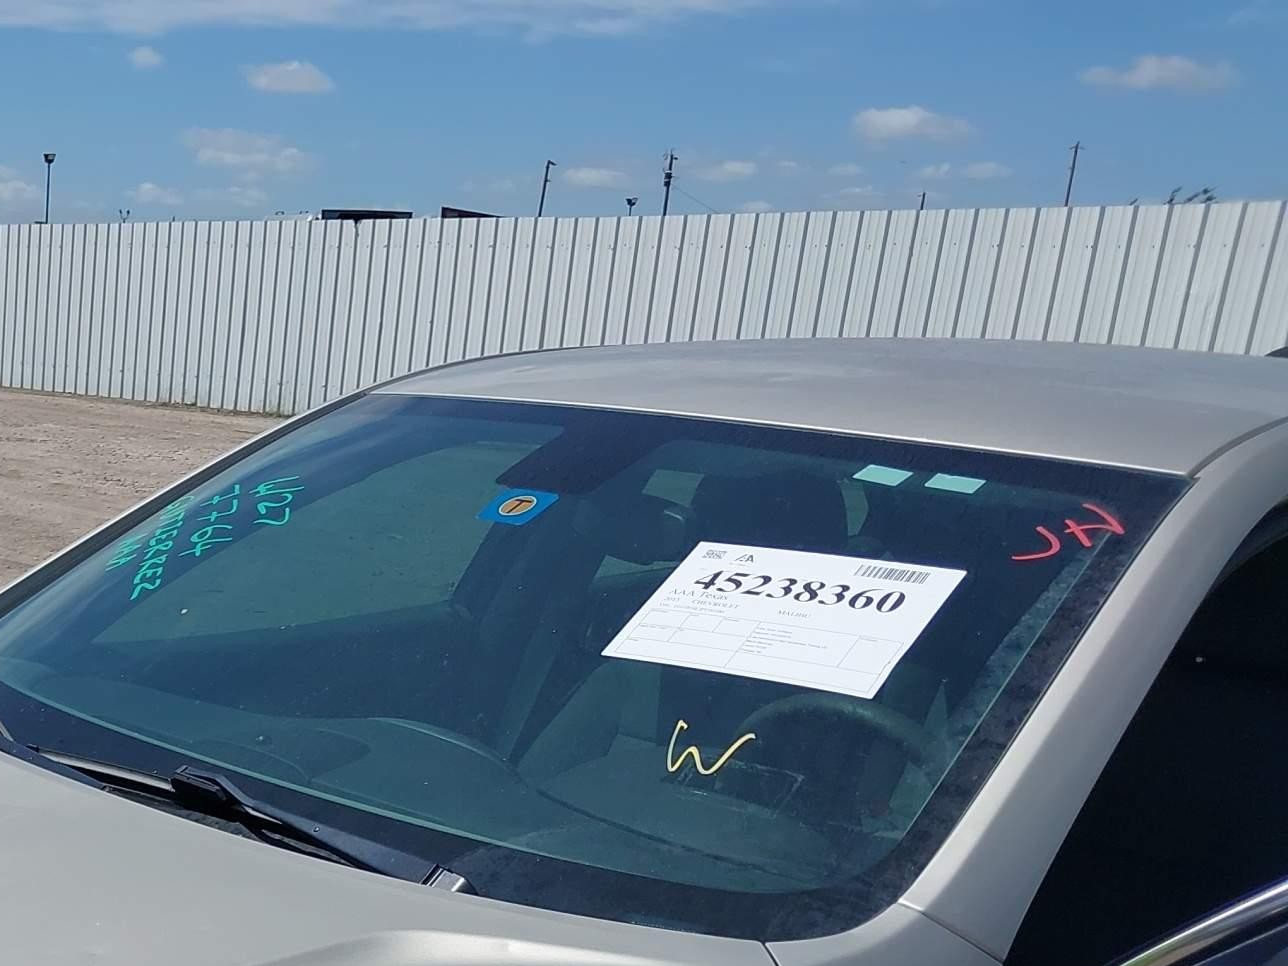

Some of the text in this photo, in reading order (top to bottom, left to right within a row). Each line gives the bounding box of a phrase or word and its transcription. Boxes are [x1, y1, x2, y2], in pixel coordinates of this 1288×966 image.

[669, 588, 728, 600] AAA Texas
[693, 570, 907, 613] 45238360
